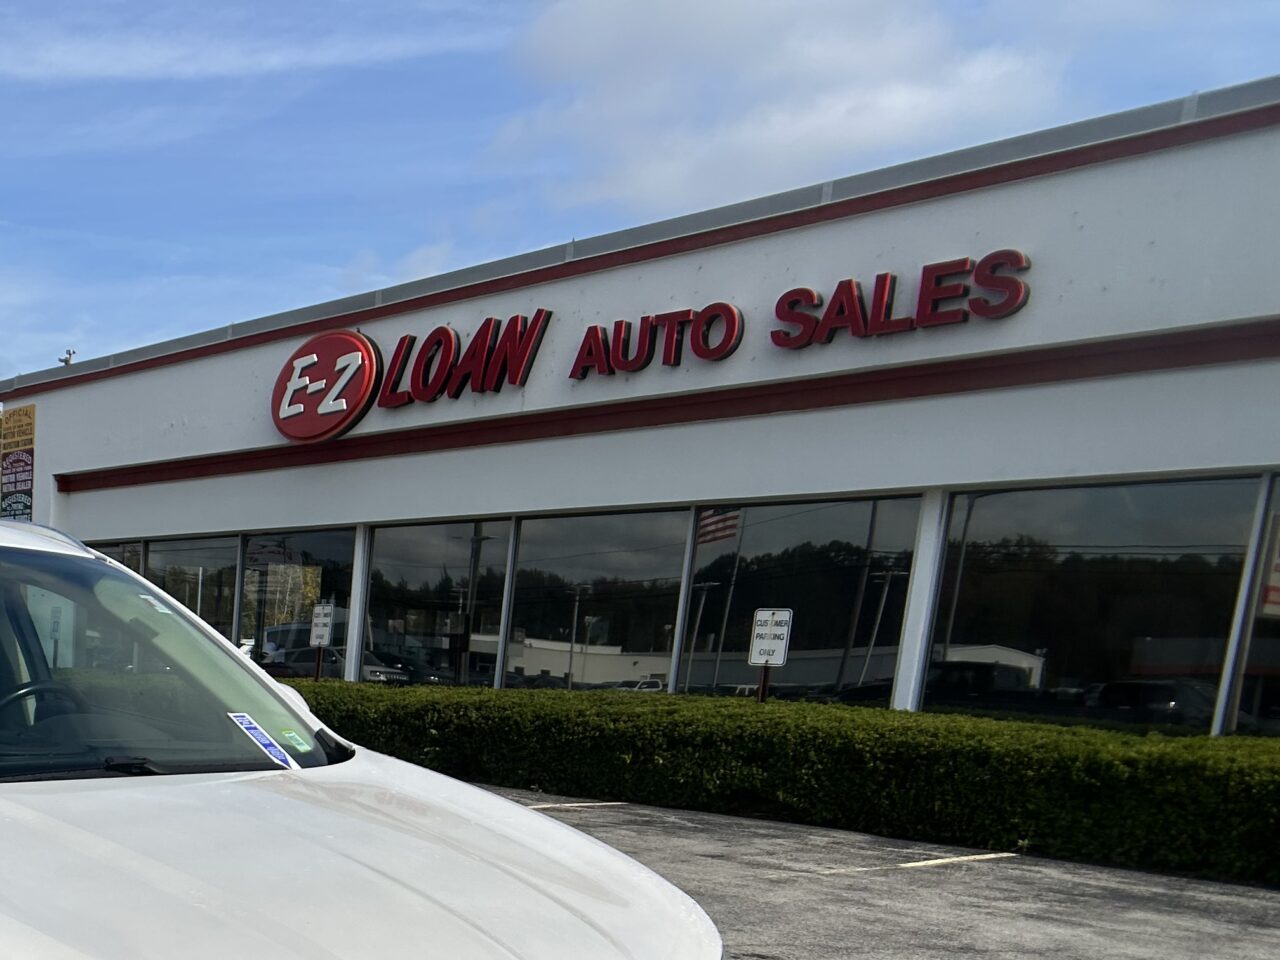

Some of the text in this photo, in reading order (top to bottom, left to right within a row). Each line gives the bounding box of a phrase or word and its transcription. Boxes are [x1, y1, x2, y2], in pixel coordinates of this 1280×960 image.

[279, 249, 1032, 420] E-Z LOAN AUTO SALES
[4, 407, 32, 424] OFFICIAL
[2, 451, 32, 469] REGISTERED
[1, 494, 32, 508] REGISTERED
[759, 648, 776, 657] ONLY
